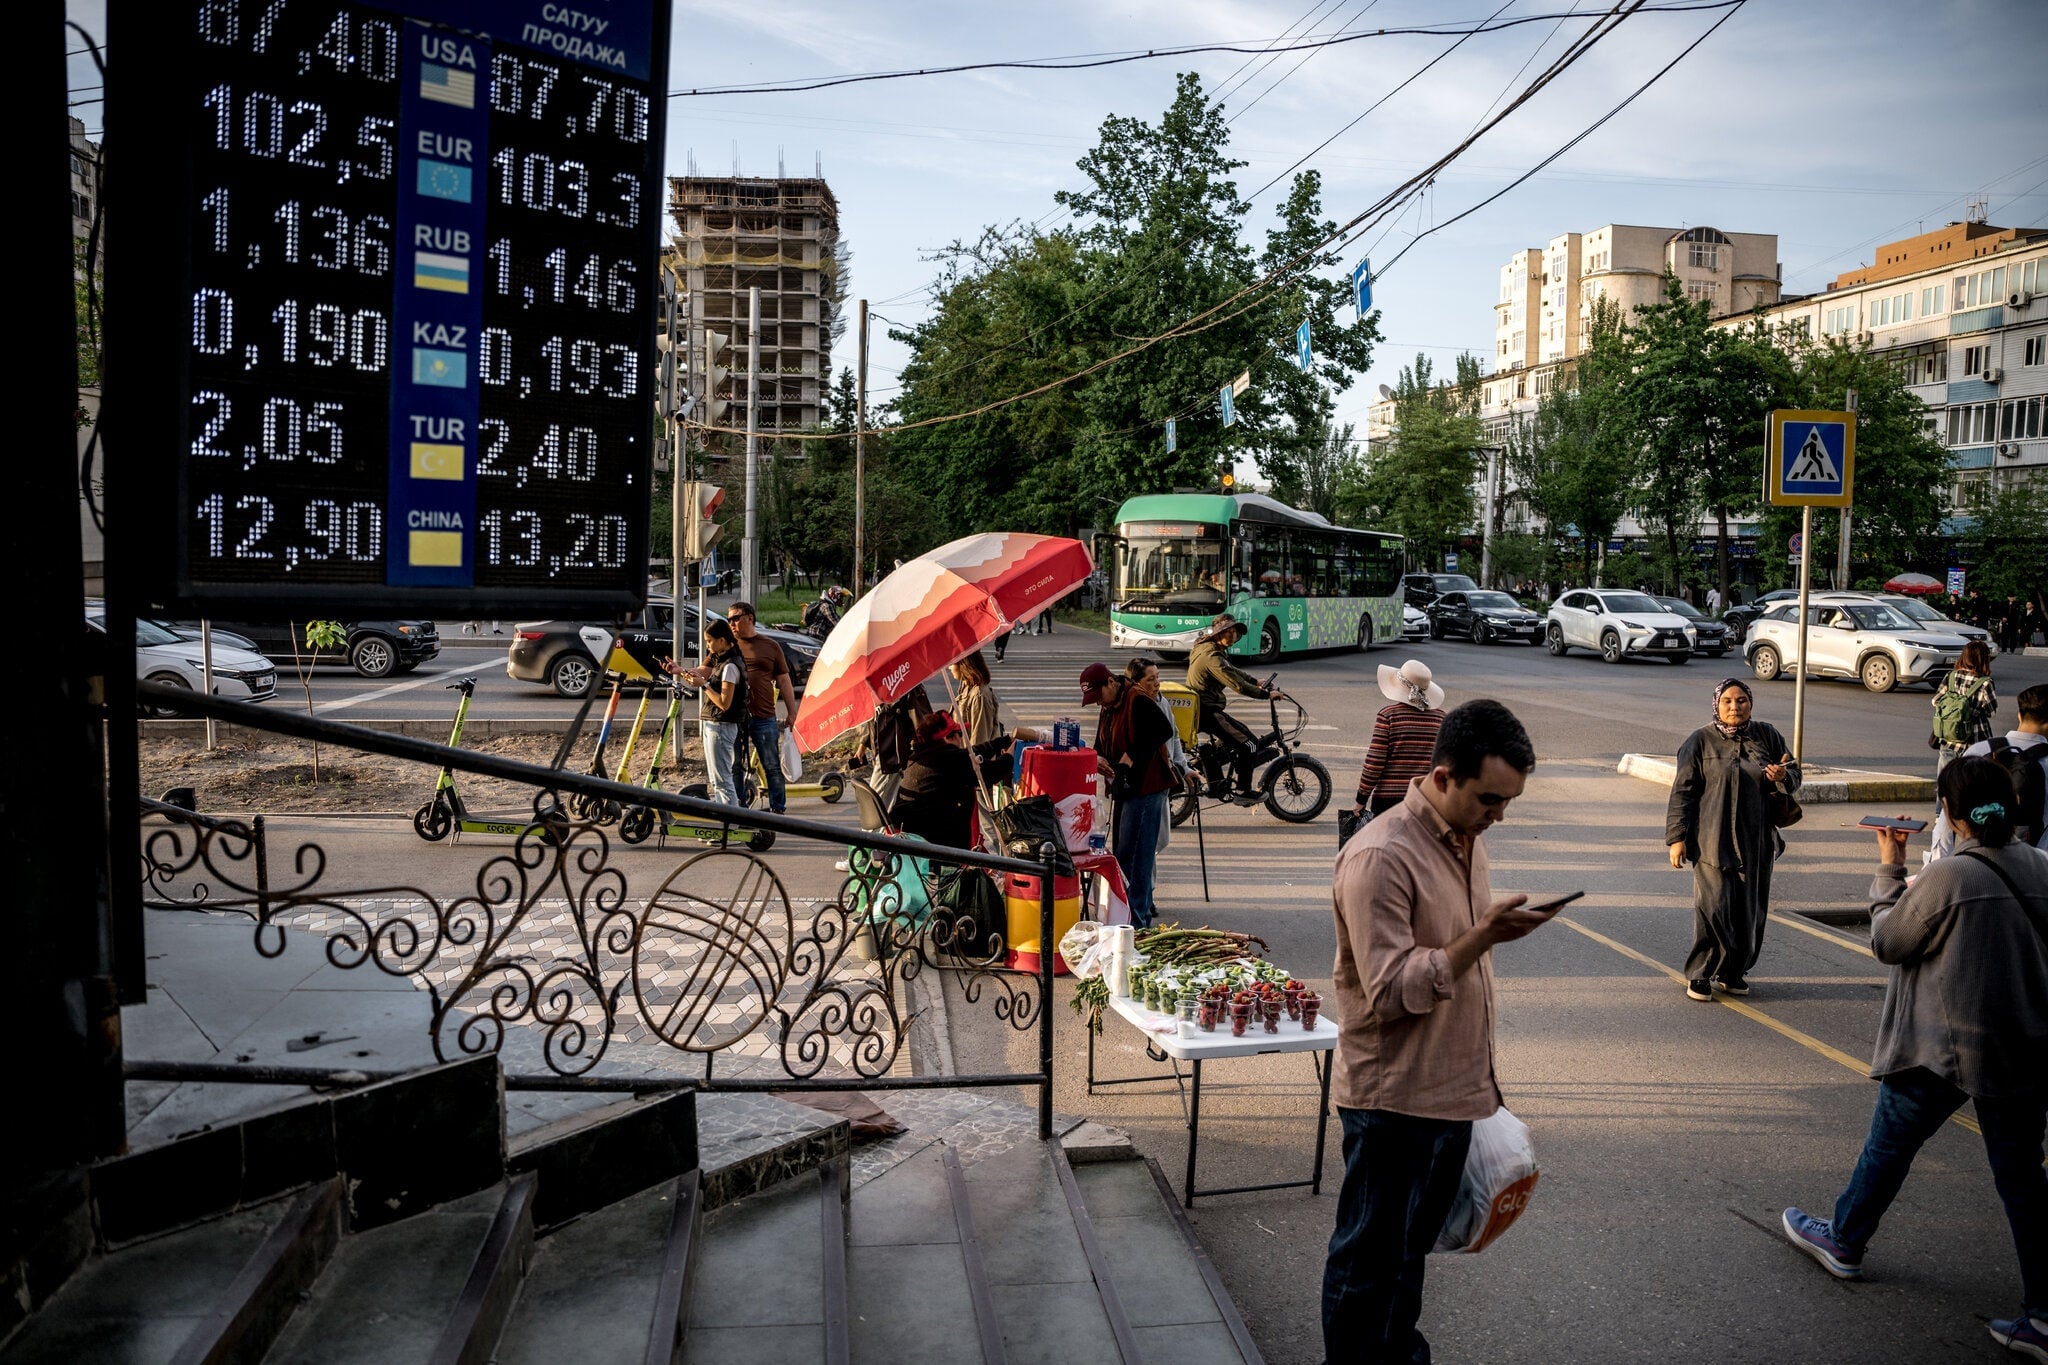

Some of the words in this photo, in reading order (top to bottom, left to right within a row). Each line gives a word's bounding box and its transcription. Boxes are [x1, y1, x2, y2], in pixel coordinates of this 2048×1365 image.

[541, 3, 609, 36] САТУУ
[421, 35, 477, 69] USA
[521, 23, 627, 69] ПРОДАЖА
[490, 52, 649, 144] 87,70
[204, 83, 395, 184] 102,5
[417, 130, 473, 163] EUR
[202, 187, 391, 276] 1,136
[414, 224, 471, 253] RUB
[489, 237, 638, 314] 1,146
[193, 287, 388, 372] 0,190
[413, 321, 467, 348] KAZ
[479, 326, 638, 399] 0,193
[191, 390, 344, 472] 2,05
[410, 415, 465, 442] TUR
[476, 417, 598, 488] 2,40
[197, 493, 382, 571] 12,90
[407, 510, 464, 529] CHINA
[480, 509, 627, 578] 13,20
[1024, 584, 1037, 596] ЭТО
[1036, 574, 1054, 588] СИЛА
[634, 634, 649, 642] 776
[1184, 618, 1200, 626] 0070
[615, 638, 622, 648] Я
